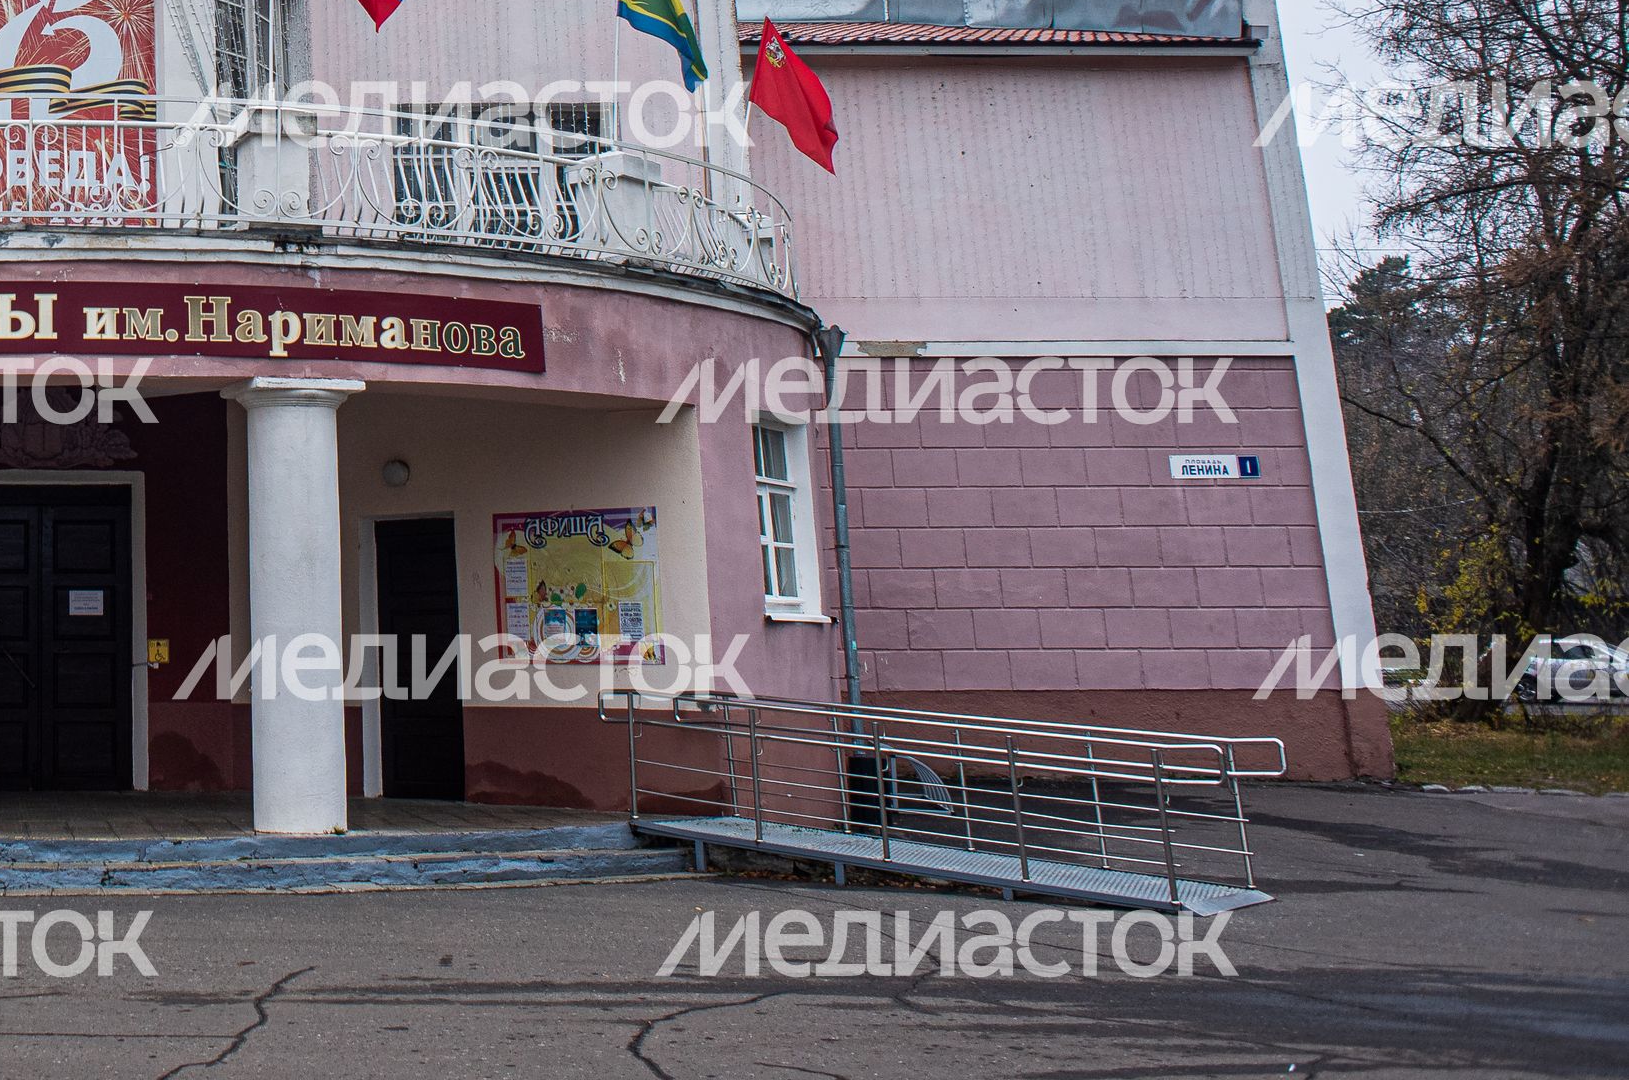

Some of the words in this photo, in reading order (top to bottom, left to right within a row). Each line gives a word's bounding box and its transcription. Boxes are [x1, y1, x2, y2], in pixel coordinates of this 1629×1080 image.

[1181, 465, 1230, 476] ЛЕНИНА
[1246, 460, 1252, 474] 1
[525, 515, 610, 548] АФИША
